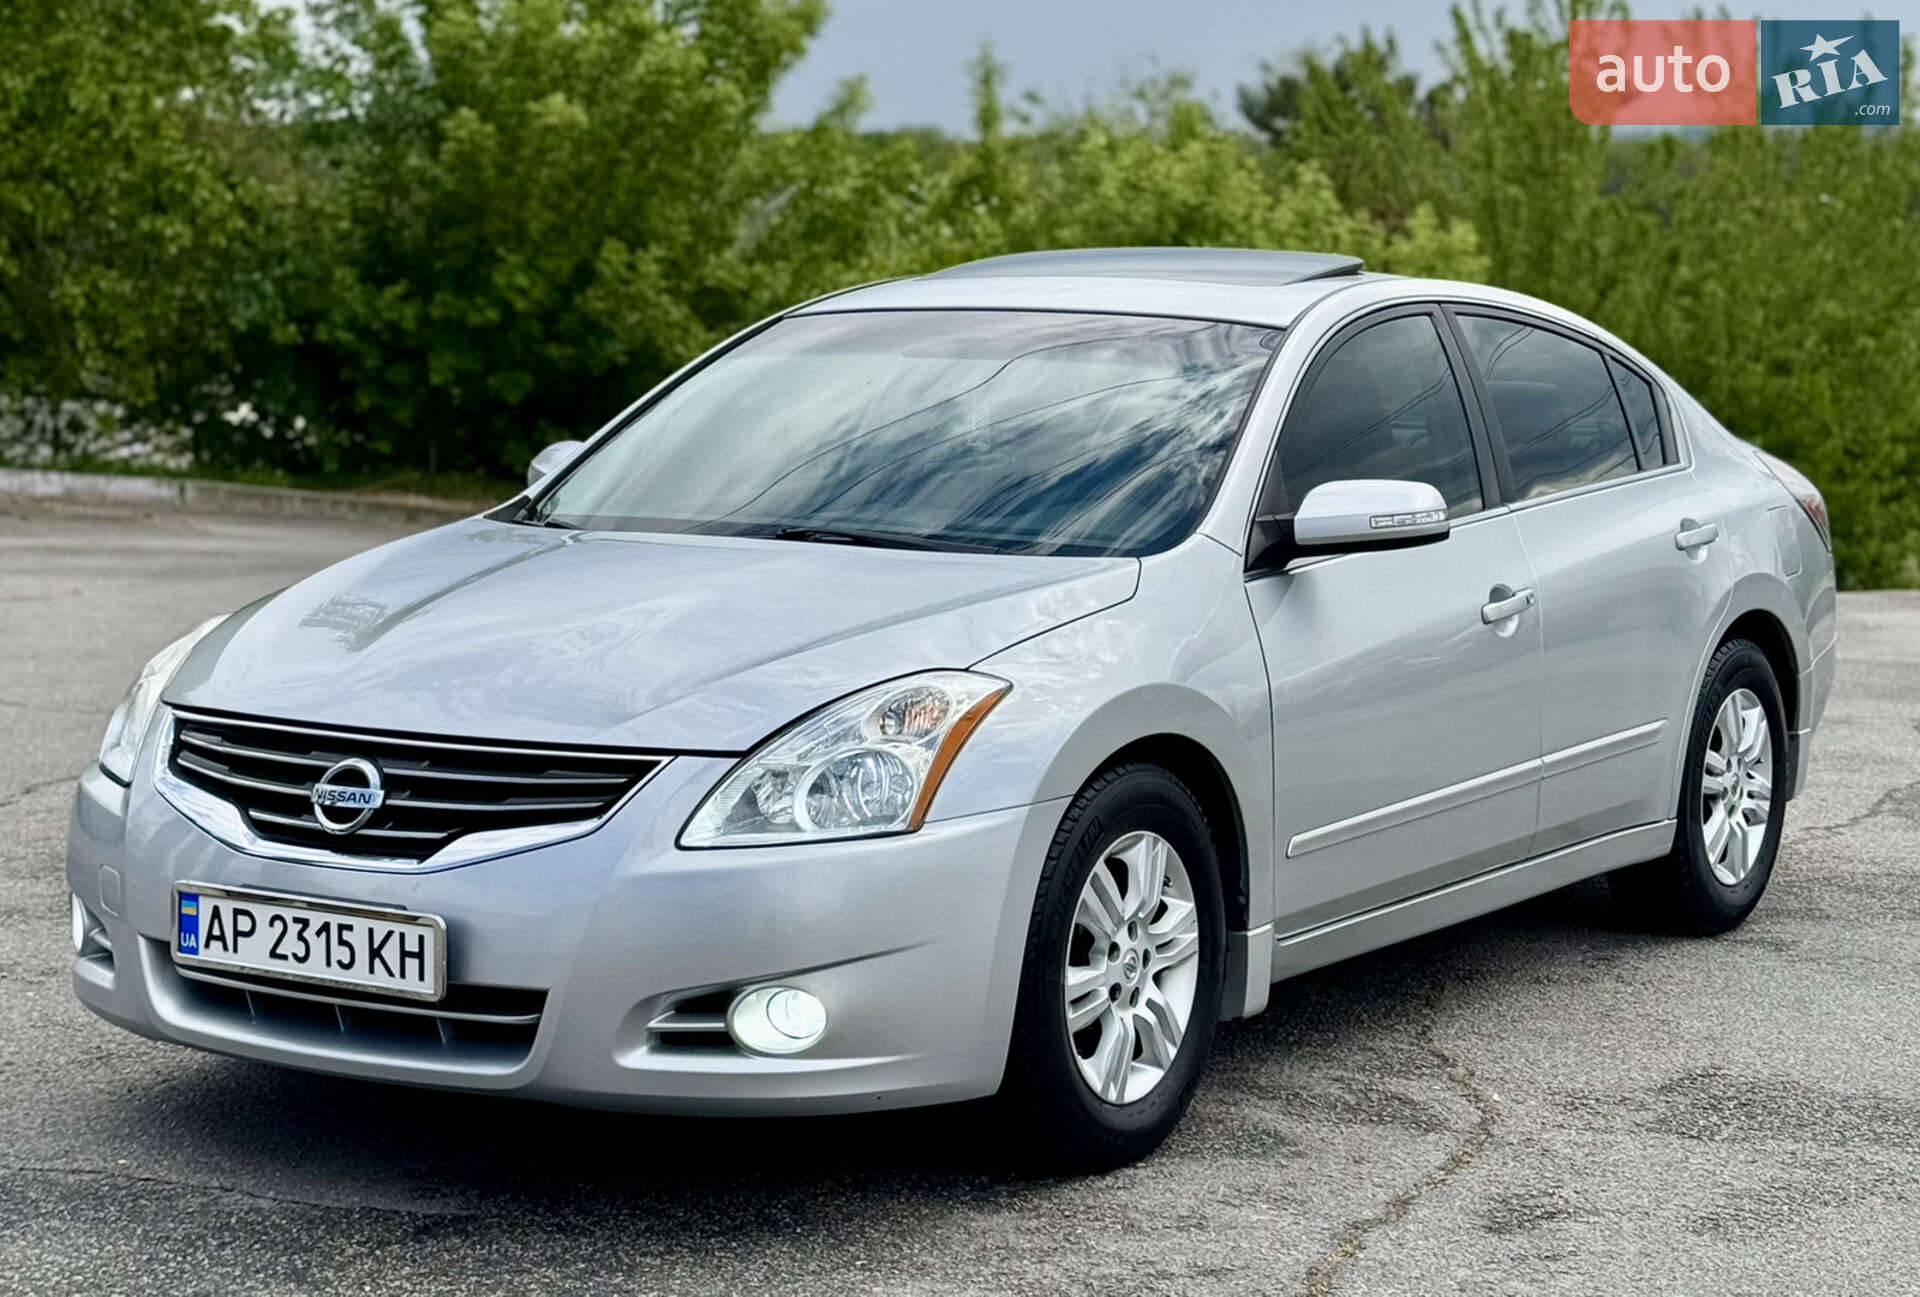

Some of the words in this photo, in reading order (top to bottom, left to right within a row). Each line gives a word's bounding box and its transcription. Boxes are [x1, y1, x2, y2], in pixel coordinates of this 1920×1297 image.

[314, 787, 372, 804] NISSAN
[180, 931, 198, 949] UA
[204, 904, 257, 954] AP
[267, 913, 356, 970] 2315
[367, 926, 425, 982] KH
